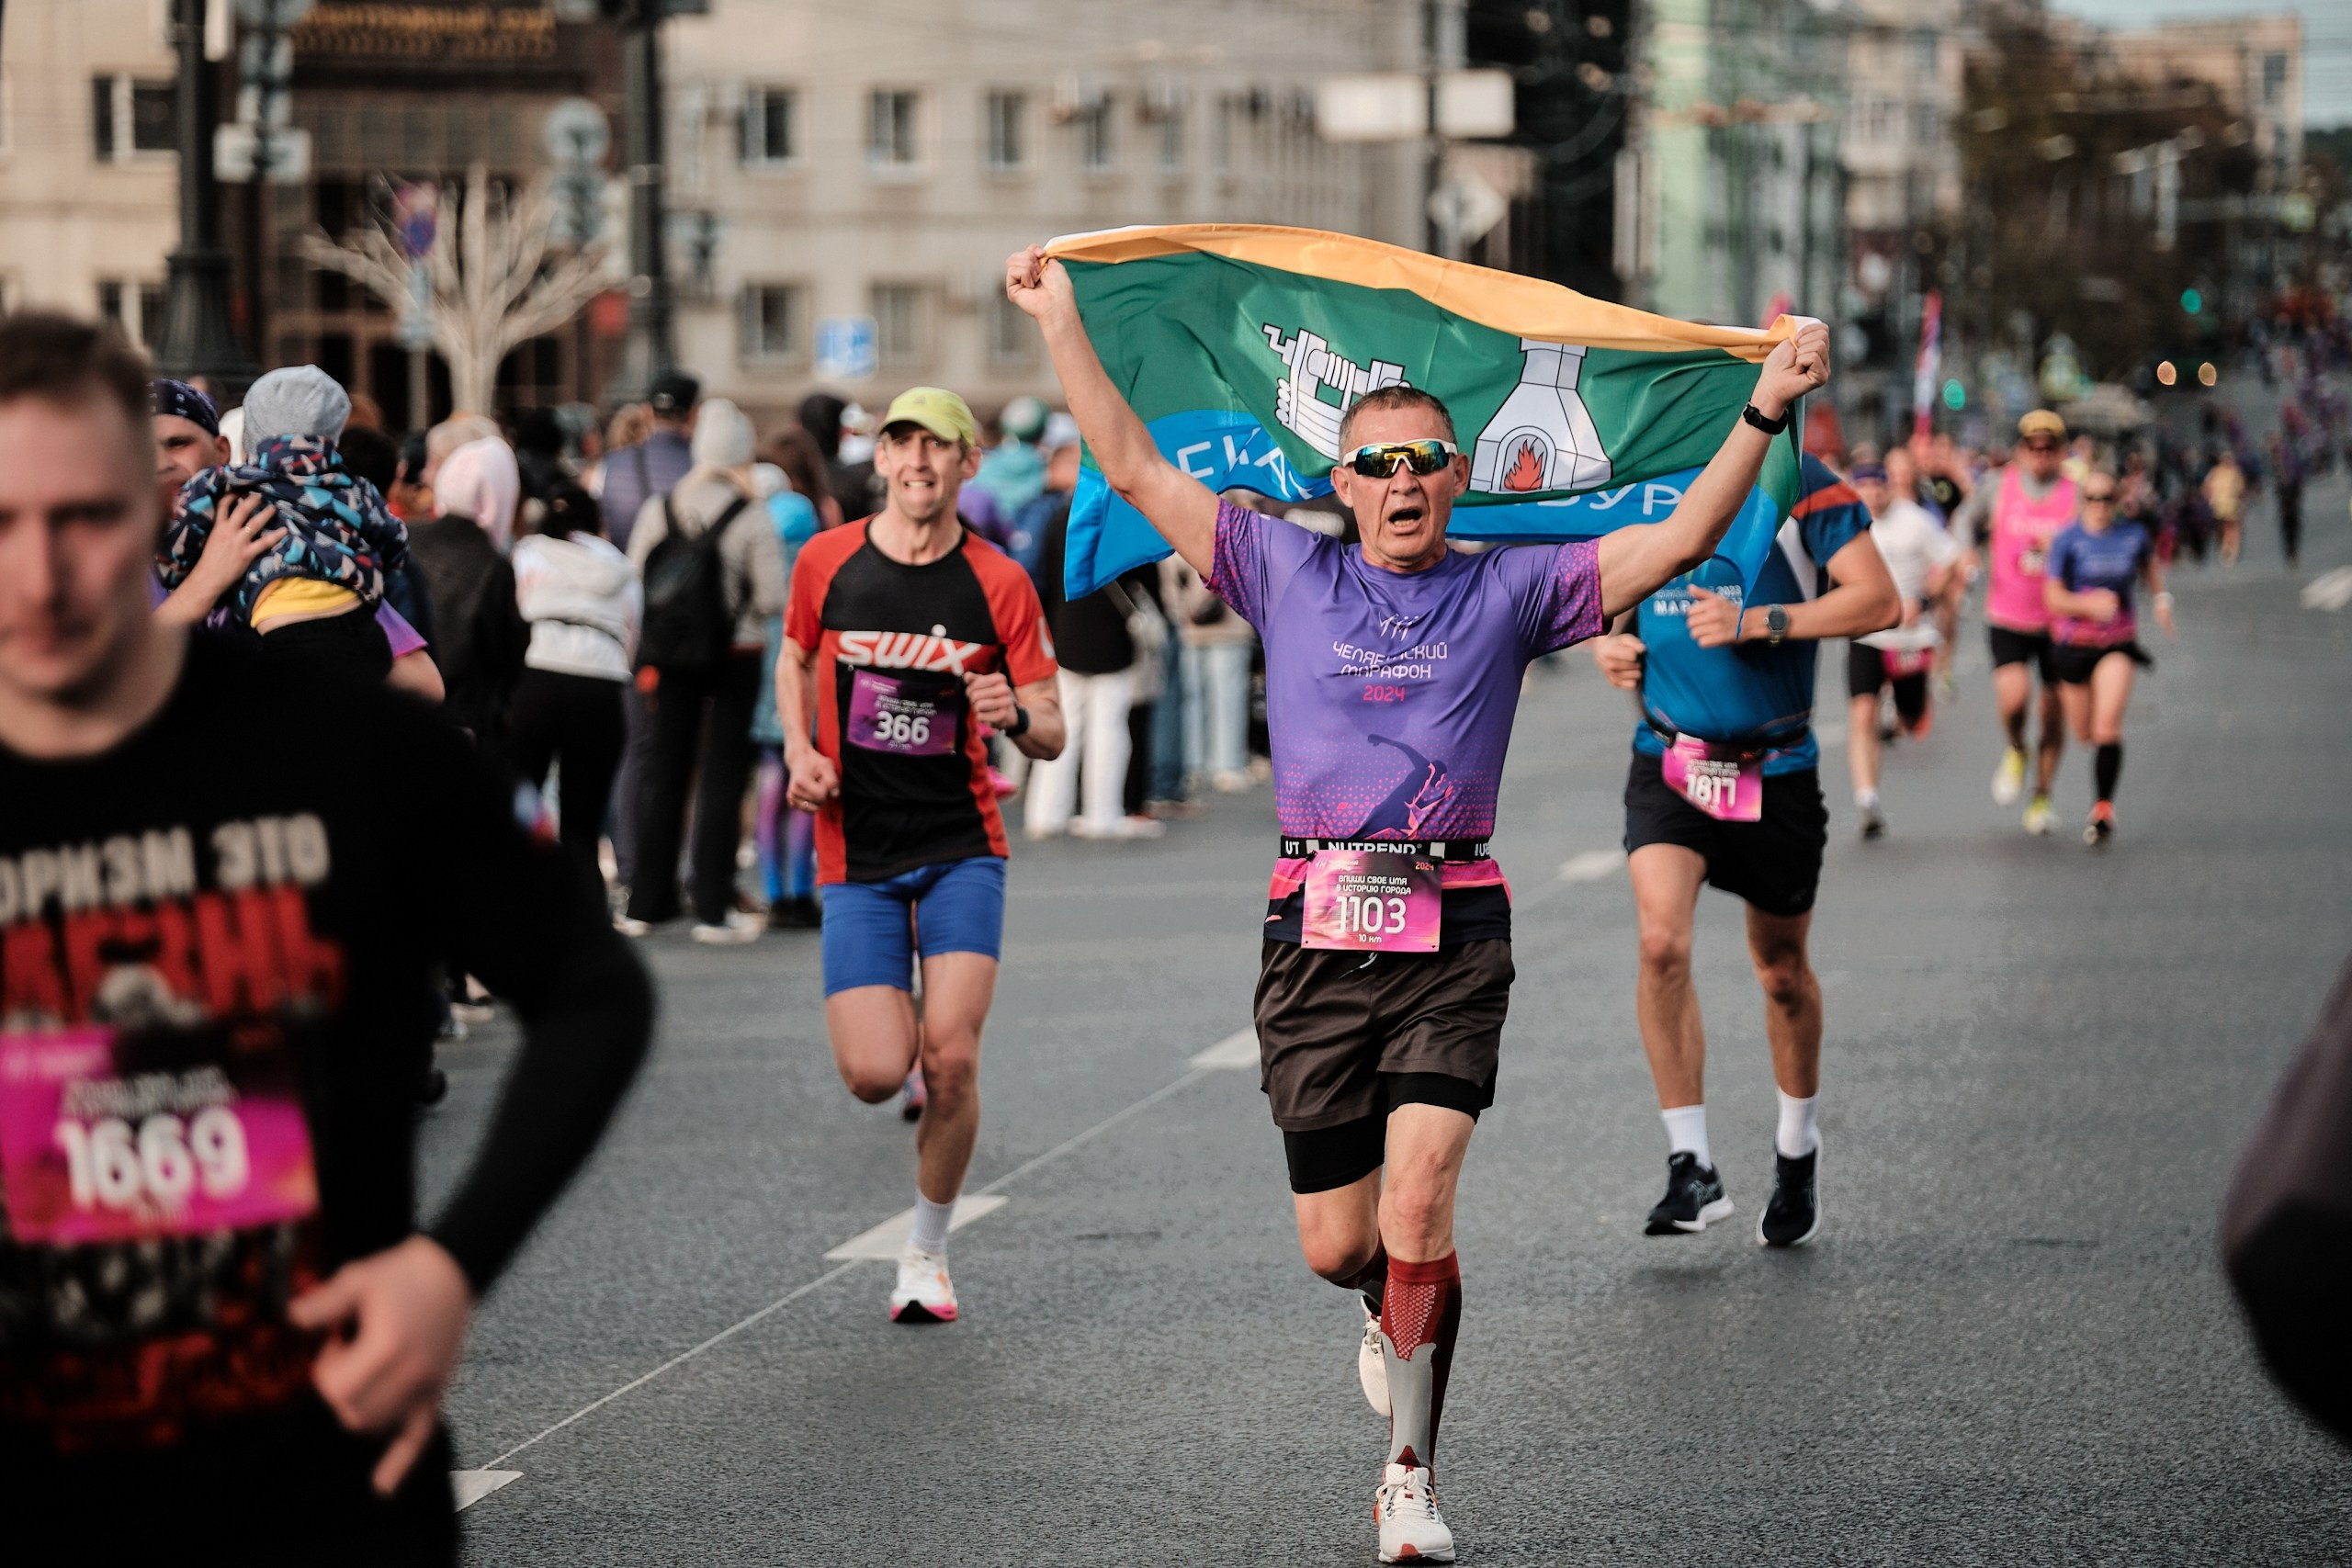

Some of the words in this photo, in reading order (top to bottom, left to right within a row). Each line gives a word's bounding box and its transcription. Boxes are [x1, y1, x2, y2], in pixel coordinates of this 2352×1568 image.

[1363, 685, 1405, 702] 2024
[873, 710, 930, 745] 366
[1684, 773, 1736, 808] 1817
[212, 812, 330, 886] ЭТО
[1415, 861, 1434, 872] 2024
[1336, 884, 1341, 892] В
[1343, 884, 1379, 893] ИСТОРИЮ
[1381, 886, 1412, 895] ГОРОДА
[1338, 874, 1365, 884] ВПИШИ
[1367, 875, 1387, 884] СВОЕ
[1389, 876, 1408, 886] ИМЯ
[1336, 896, 1407, 934] 1103
[1359, 933, 1367, 942] 10
[54, 1105, 248, 1212] 1669
